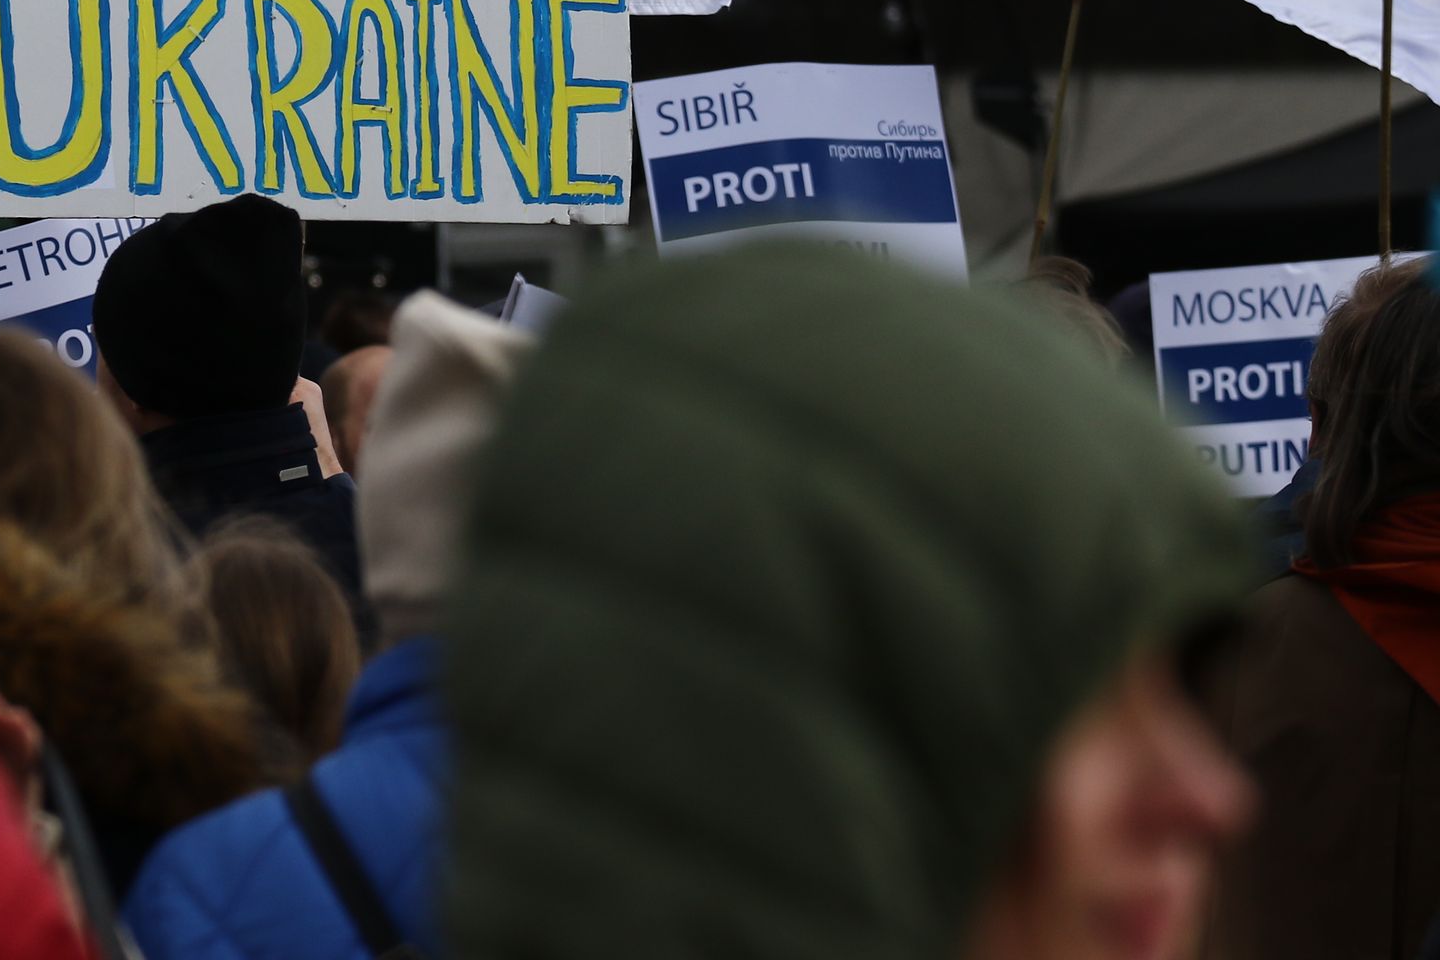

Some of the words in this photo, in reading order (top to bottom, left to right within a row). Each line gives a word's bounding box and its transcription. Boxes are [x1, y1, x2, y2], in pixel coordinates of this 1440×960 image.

[656, 82, 758, 135] SIBIŘ
[877, 120, 937, 139] Сибирь
[828, 143, 882, 161] против
[884, 142, 943, 162] Путина
[683, 163, 815, 213] PROTI
[1172, 283, 1328, 327] MOSKVA
[1188, 361, 1303, 404] PROTI
[1197, 438, 1309, 476] PUTIN
